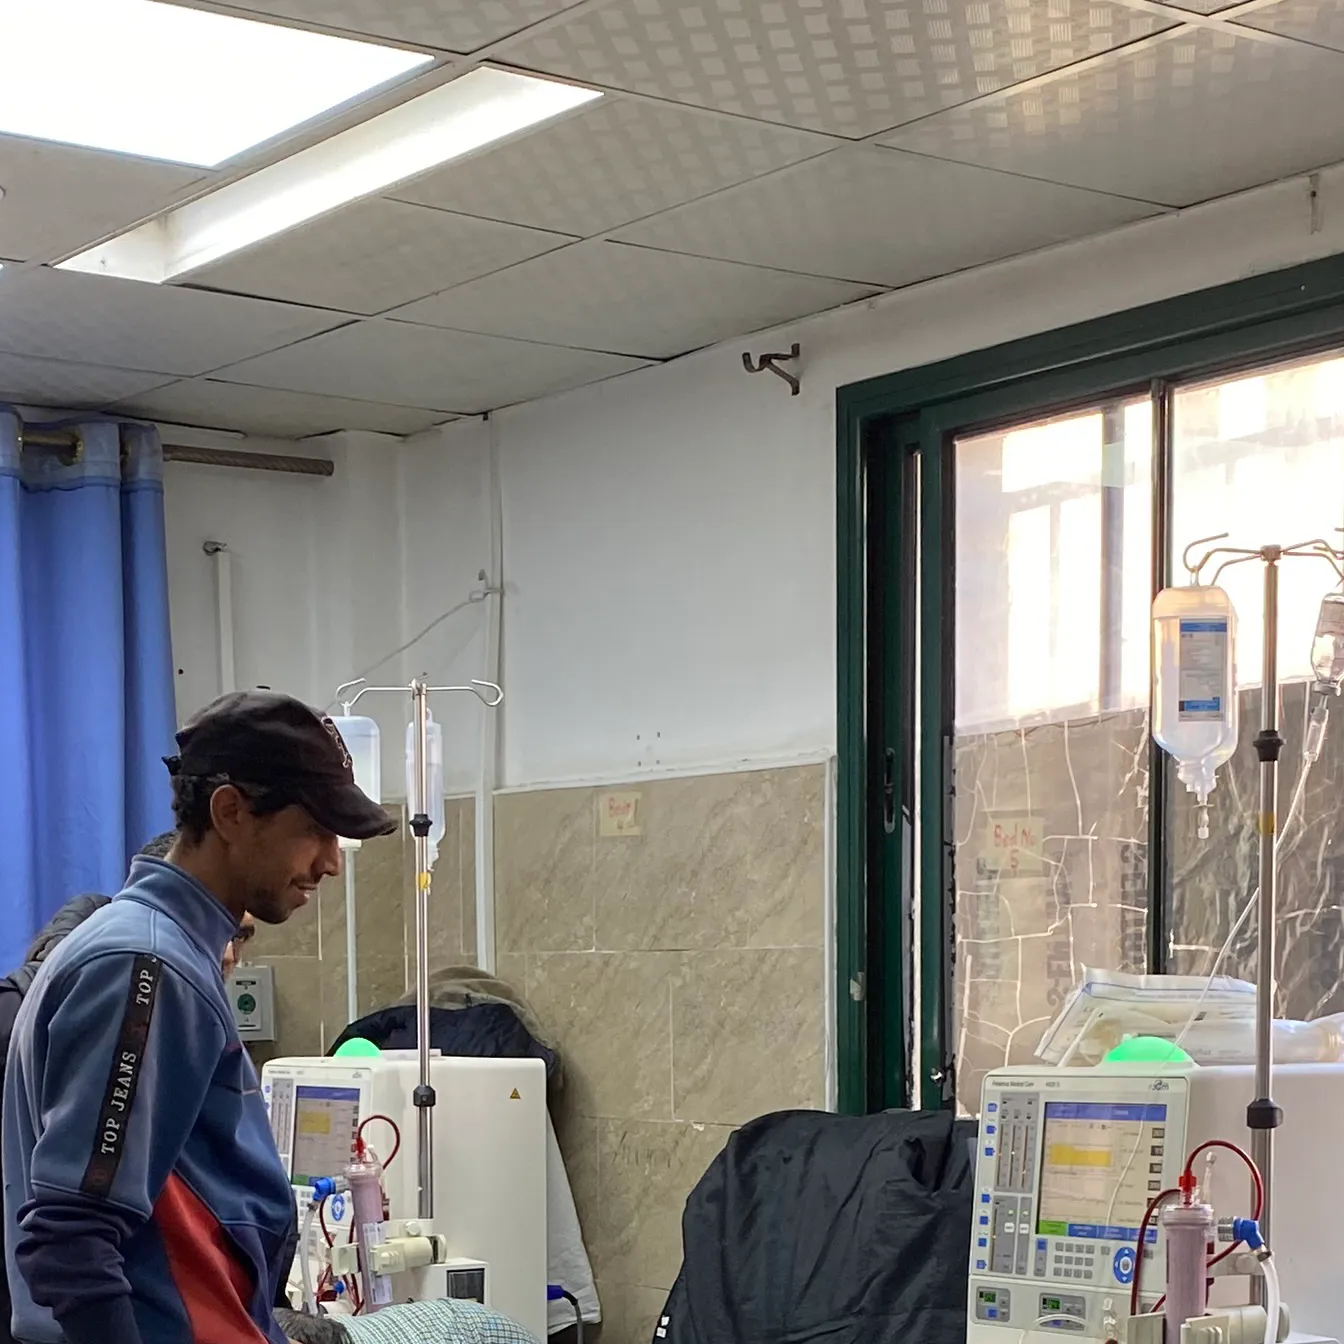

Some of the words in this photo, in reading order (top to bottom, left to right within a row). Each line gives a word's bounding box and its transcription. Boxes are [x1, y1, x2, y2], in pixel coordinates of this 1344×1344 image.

[136, 969, 154, 1005] TOP
[101, 1118, 120, 1154] TOP
[111, 1052, 137, 1112] JEANS
